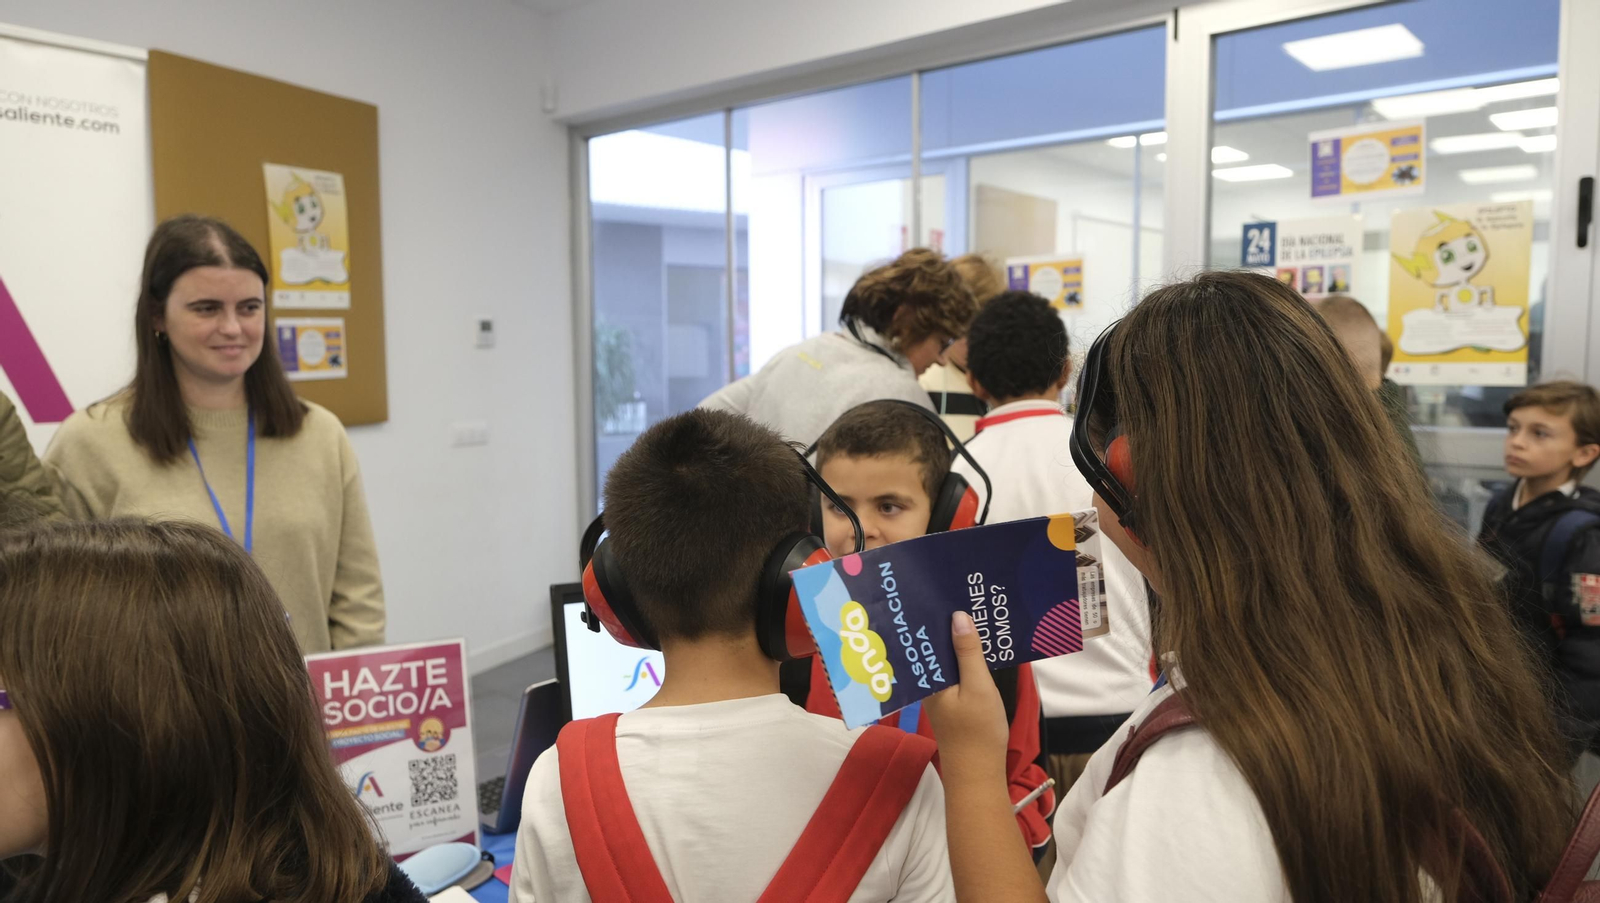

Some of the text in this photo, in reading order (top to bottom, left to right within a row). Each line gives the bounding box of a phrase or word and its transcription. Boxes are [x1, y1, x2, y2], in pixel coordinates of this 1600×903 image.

[36, 95, 119, 118] NOSOTROS
[1247, 227, 1271, 252] 24
[1282, 250, 1293, 261] DE
[1295, 249, 1307, 261] LA
[1299, 233, 1344, 247] NACIONAL
[878, 562, 932, 689] ASOCIACIÓN
[990, 584, 1015, 662] SOMOS?
[915, 625, 946, 683] ANDA
[323, 657, 448, 700] HAZTE
[323, 687, 453, 726] SOCIO/A
[409, 803, 461, 819] ESCANEA
